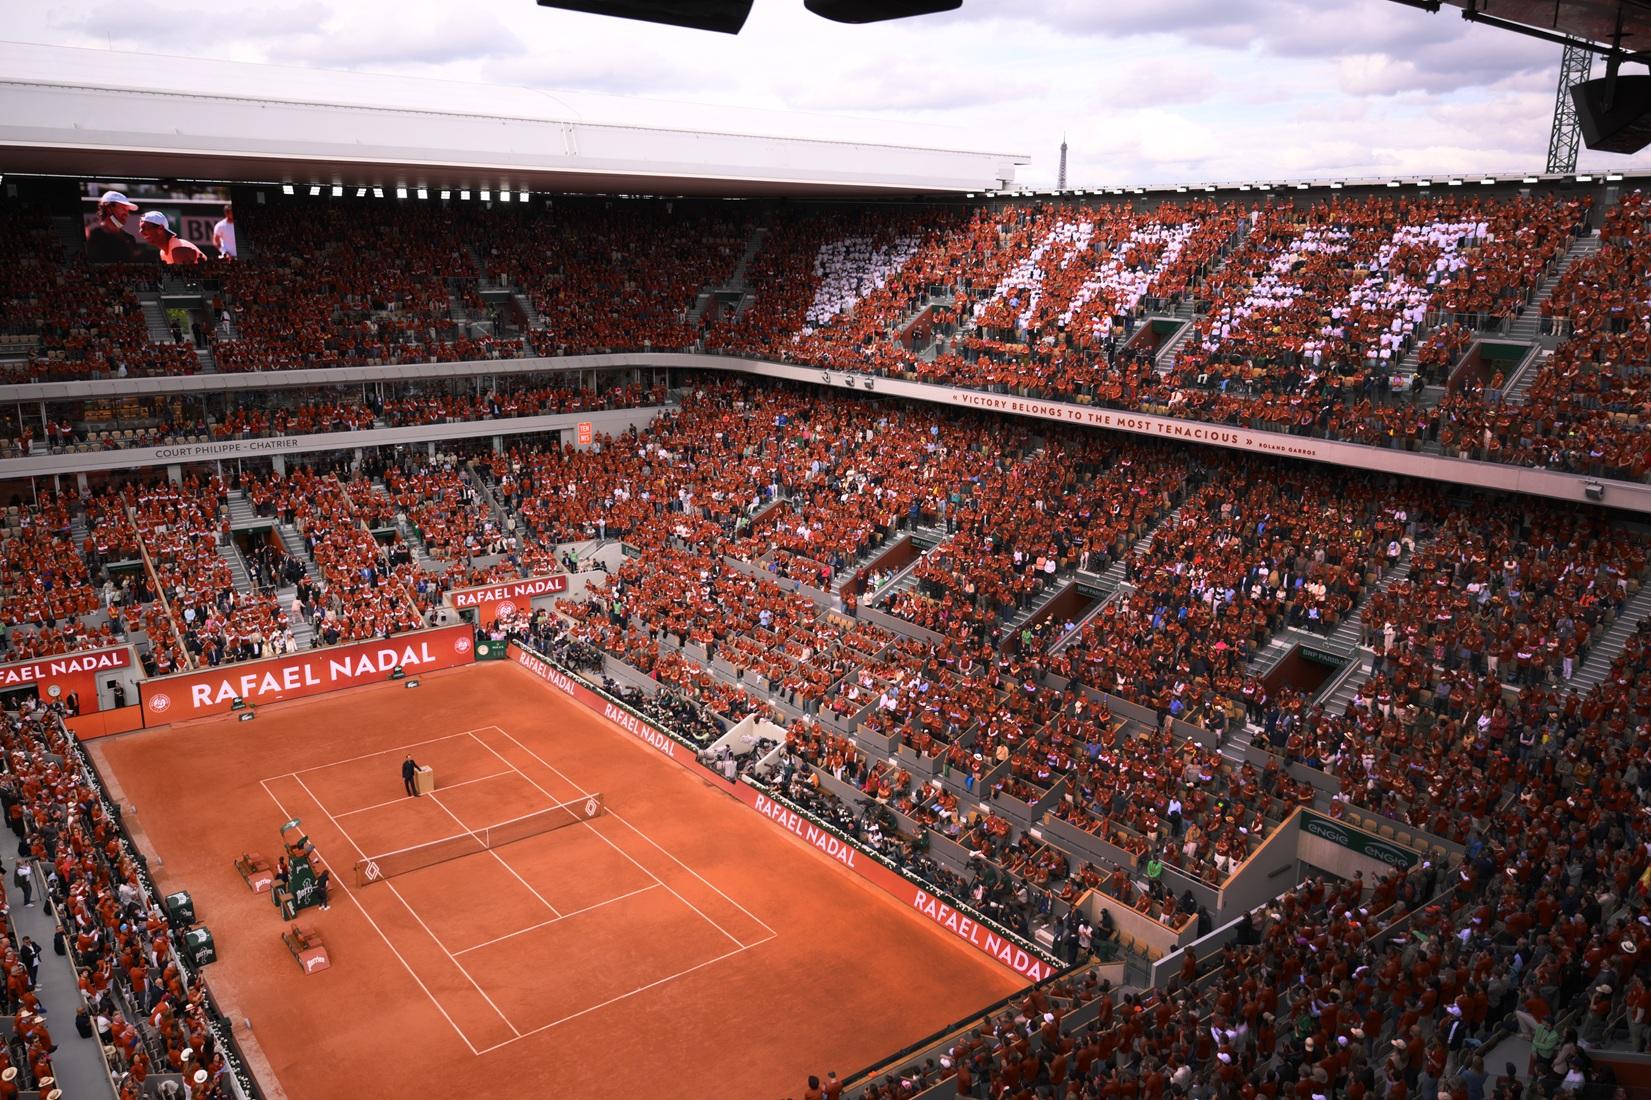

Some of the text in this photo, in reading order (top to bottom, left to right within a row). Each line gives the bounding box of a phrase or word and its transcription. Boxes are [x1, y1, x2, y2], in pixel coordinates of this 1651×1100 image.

[962, 394, 1007, 409] VICTORY
[1012, 402, 1062, 417] BELONGS
[1068, 410, 1082, 420] TO
[1088, 413, 1111, 424] THE
[1117, 418, 1151, 430] MOST
[1157, 423, 1238, 444] TENACIOUS
[155, 447, 192, 458] COURT
[195, 443, 241, 455] PHILIPPE
[250, 439, 298, 450] CHATRIER
[1258, 442, 1316, 456] ROLAND GARROS
[457, 578, 562, 606] RAFAEL NADAL
[51, 652, 123, 676] NADAL
[191, 664, 320, 708] RAFAEL
[329, 642, 436, 681] NADAL
[519, 651, 575, 695] RAFAEL NADAL
[604, 703, 675, 757] RAFAEL NADAL
[755, 794, 855, 868] RAFAEL NADAL
[913, 889, 979, 945] RAFAEL
